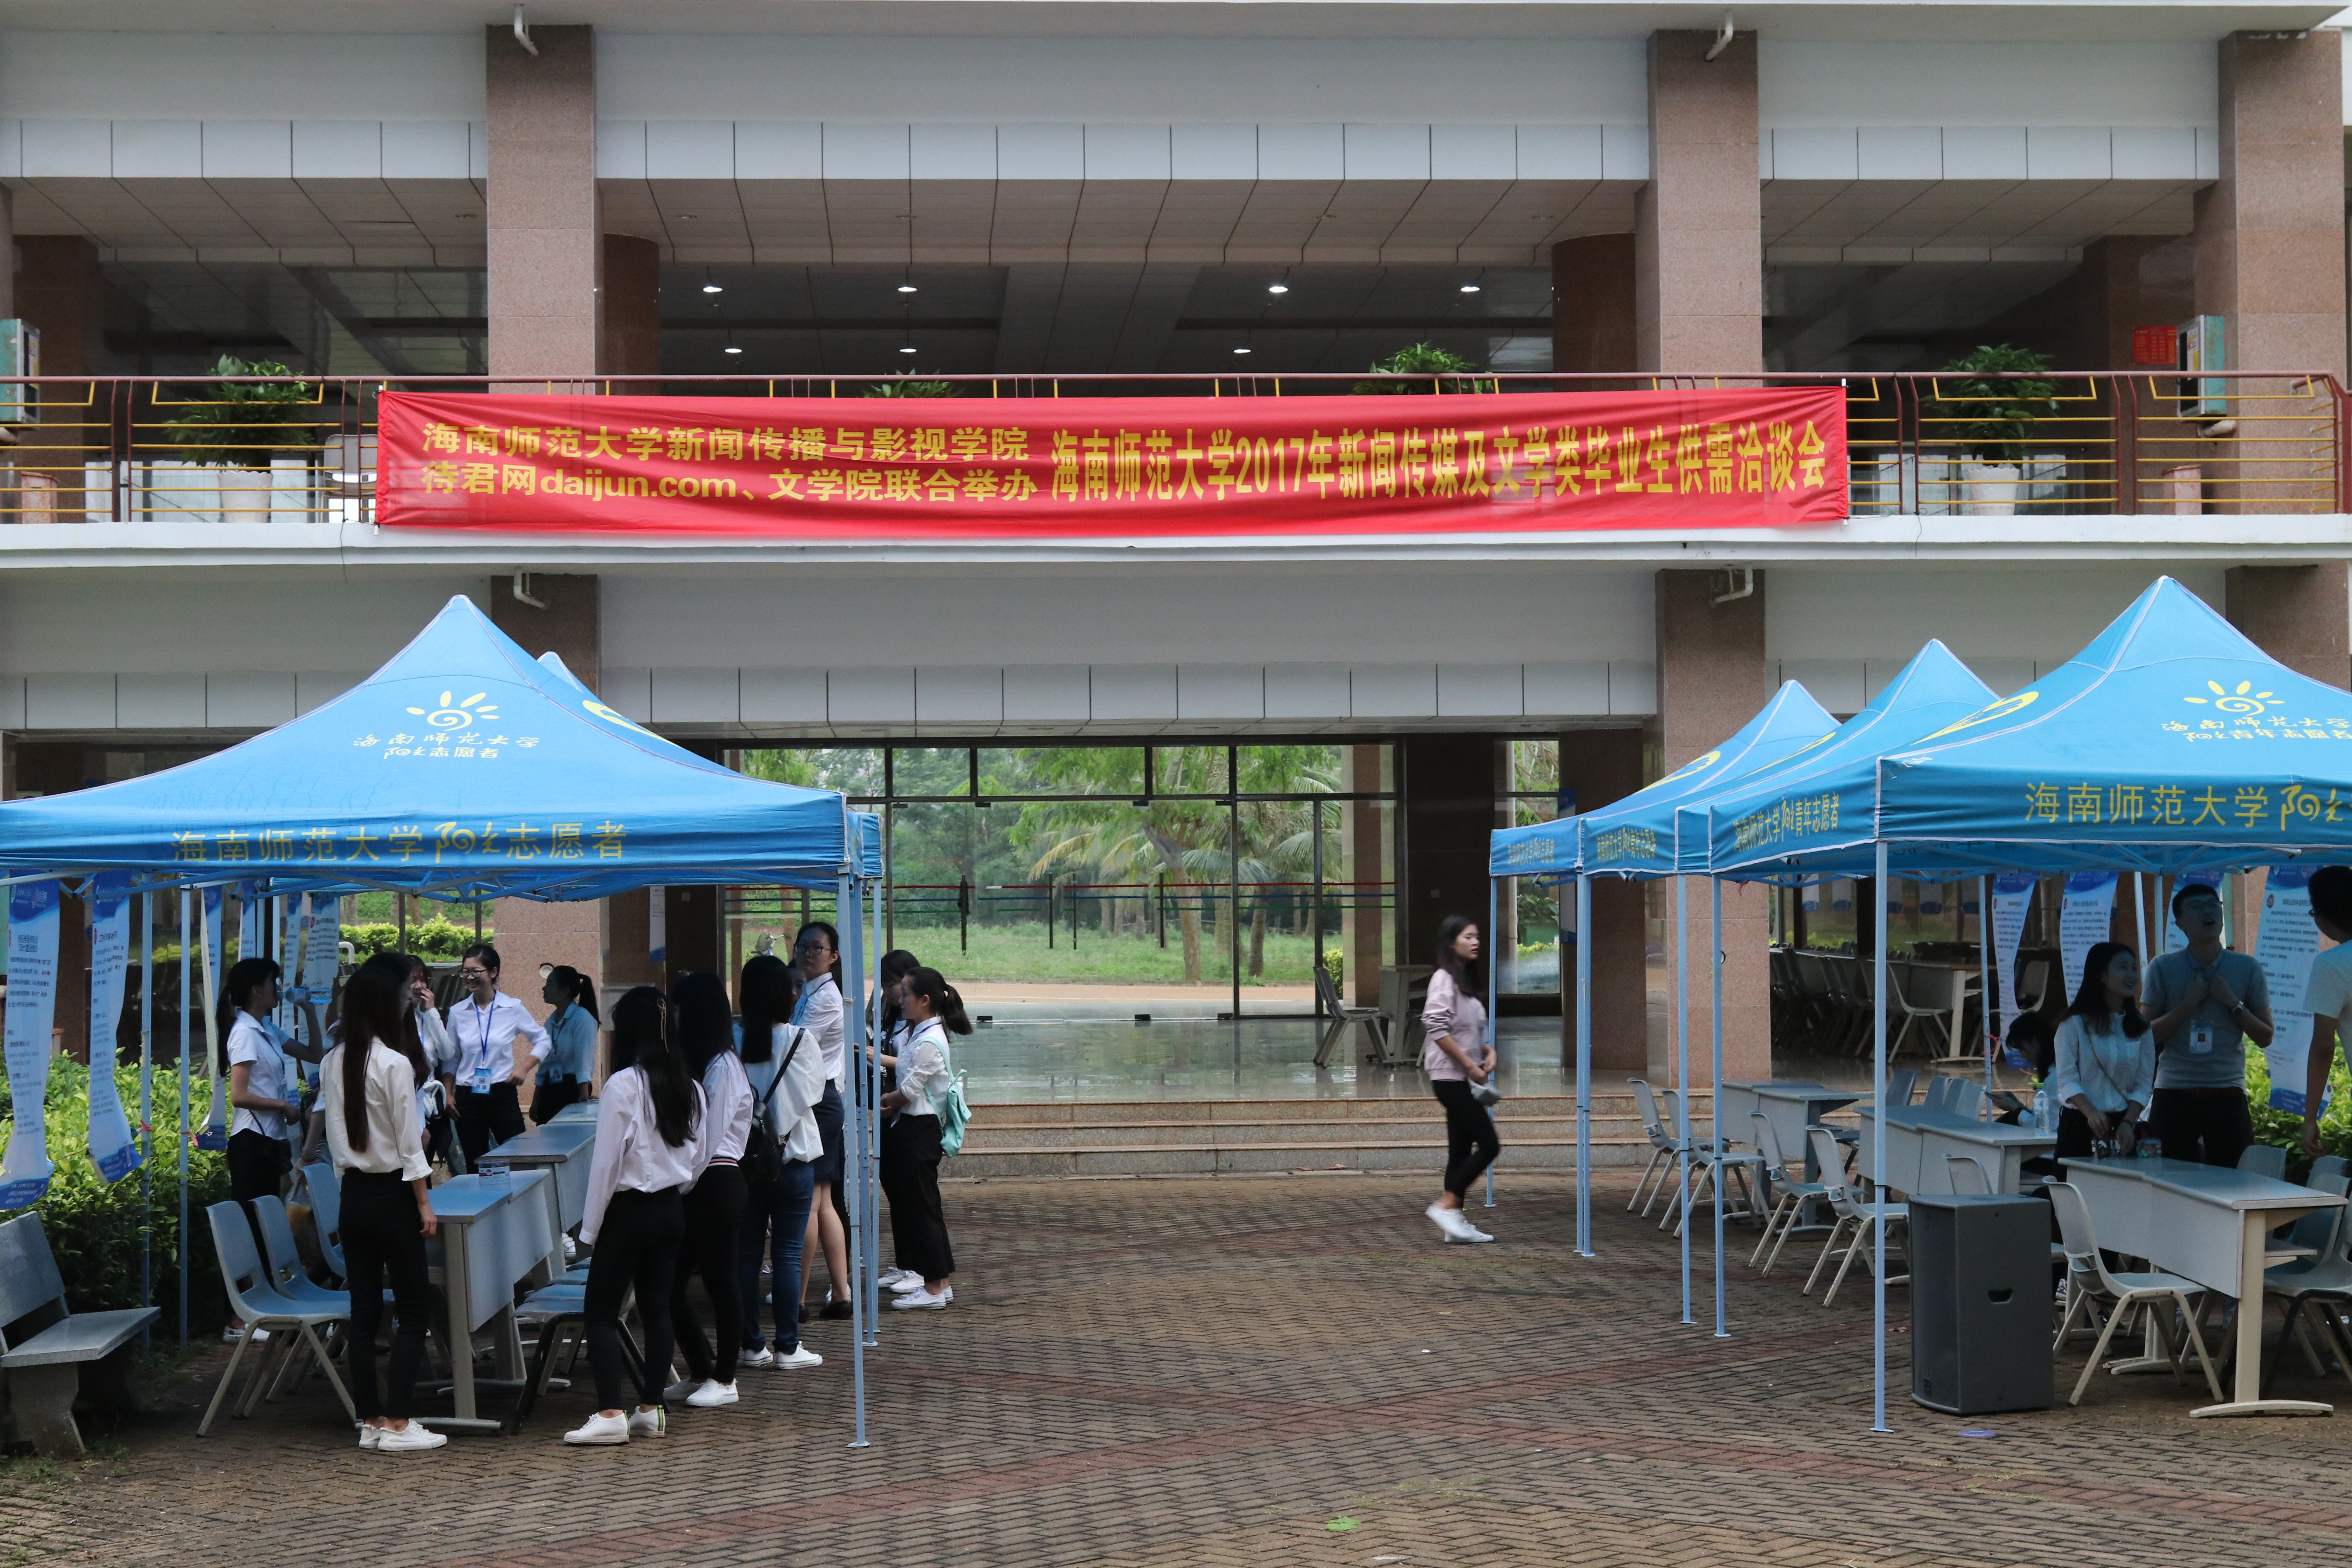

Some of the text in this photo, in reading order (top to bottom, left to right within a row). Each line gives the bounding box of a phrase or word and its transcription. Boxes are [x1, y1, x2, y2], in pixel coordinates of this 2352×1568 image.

[423, 423, 1029, 461] 海南师范大学新闻传播与影视学院
[1051, 420, 1826, 502] 海南师范大学2017年新闻传媒及文学类毕业生供需洽谈会
[352, 732, 540, 748] 海南师范大学
[2161, 716, 2351, 732] 海南师范大学
[2025, 782, 2352, 831] 海南师范大学阳光
